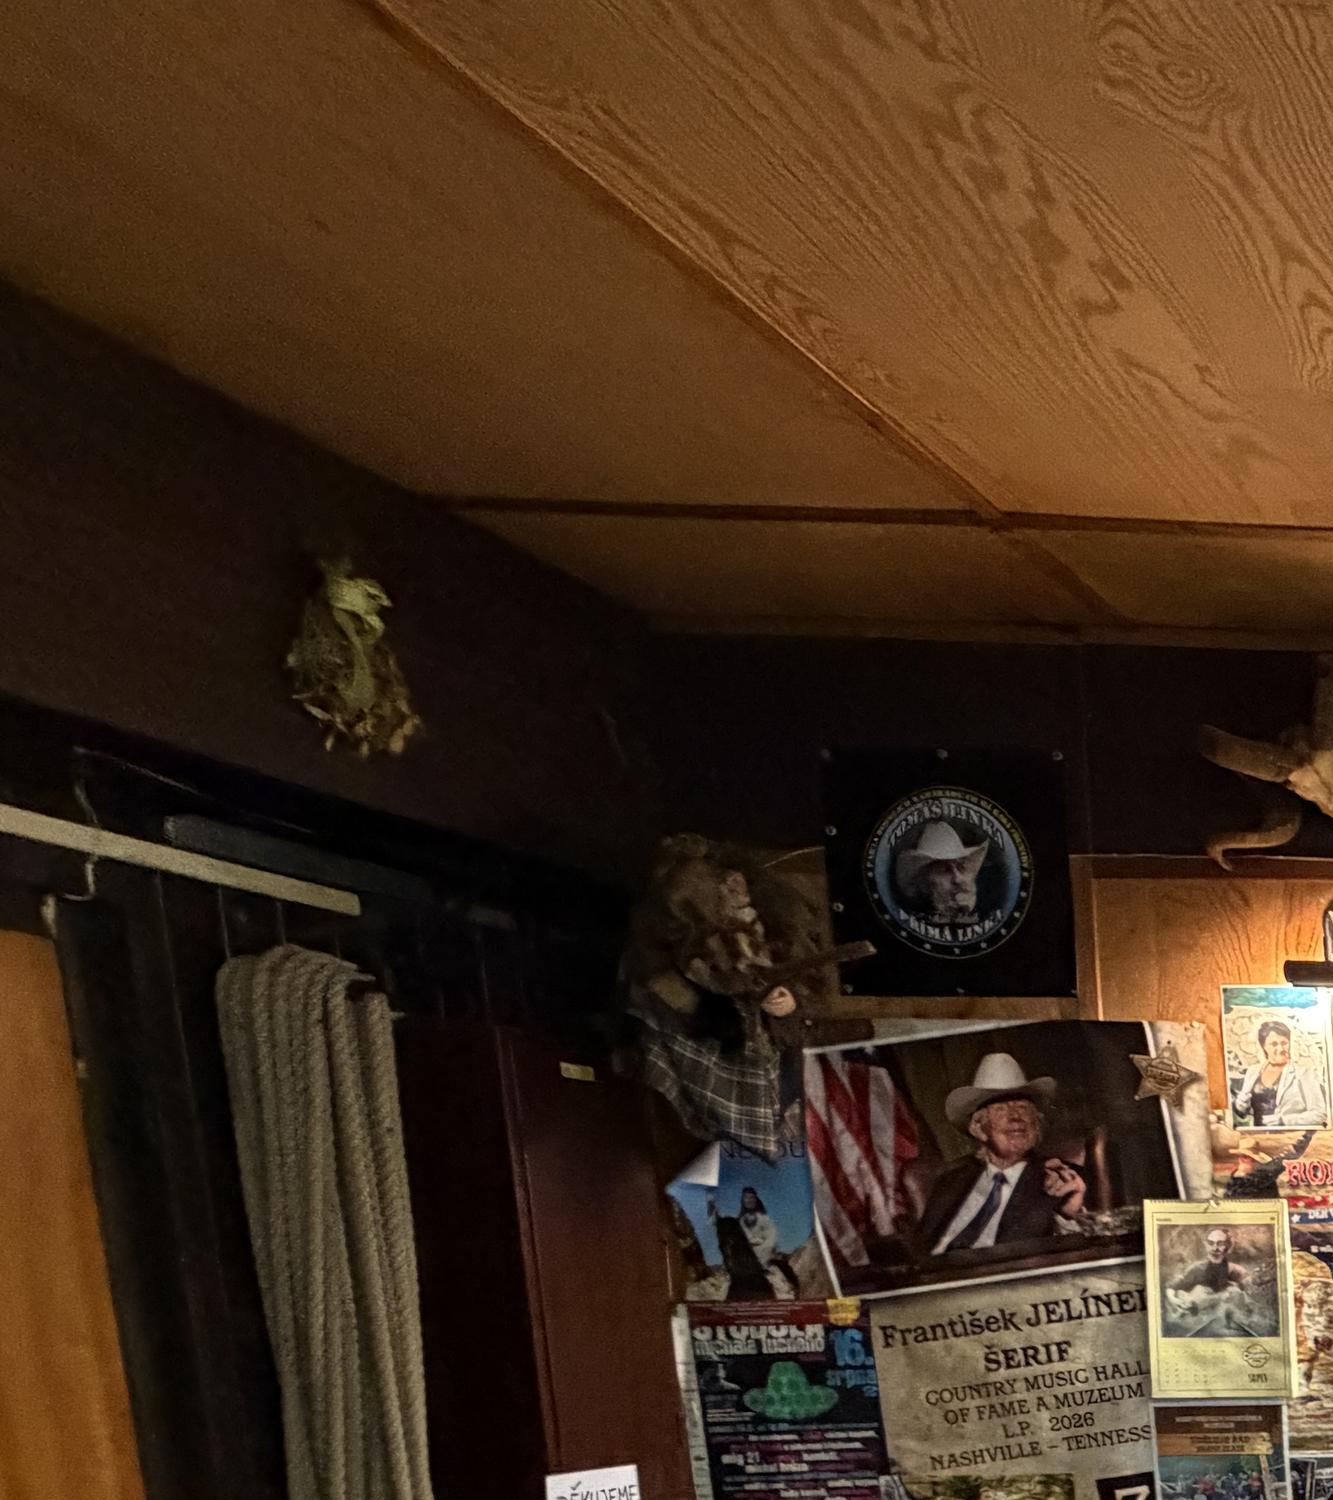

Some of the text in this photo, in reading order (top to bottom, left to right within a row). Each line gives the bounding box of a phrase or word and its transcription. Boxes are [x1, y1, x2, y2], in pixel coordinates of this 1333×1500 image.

[879, 1303, 1019, 1350] František
[982, 1339, 1073, 1373] ŠERIF
[1095, 1360, 1150, 1382] HALL
[924, 1369, 1091, 1407] COUNTRY MUSIC
[943, 1382, 1145, 1427] OF FAME A MUZEUM
[1050, 1412, 1096, 1432] 2026
[930, 1440, 1042, 1472] NASHVILLE
